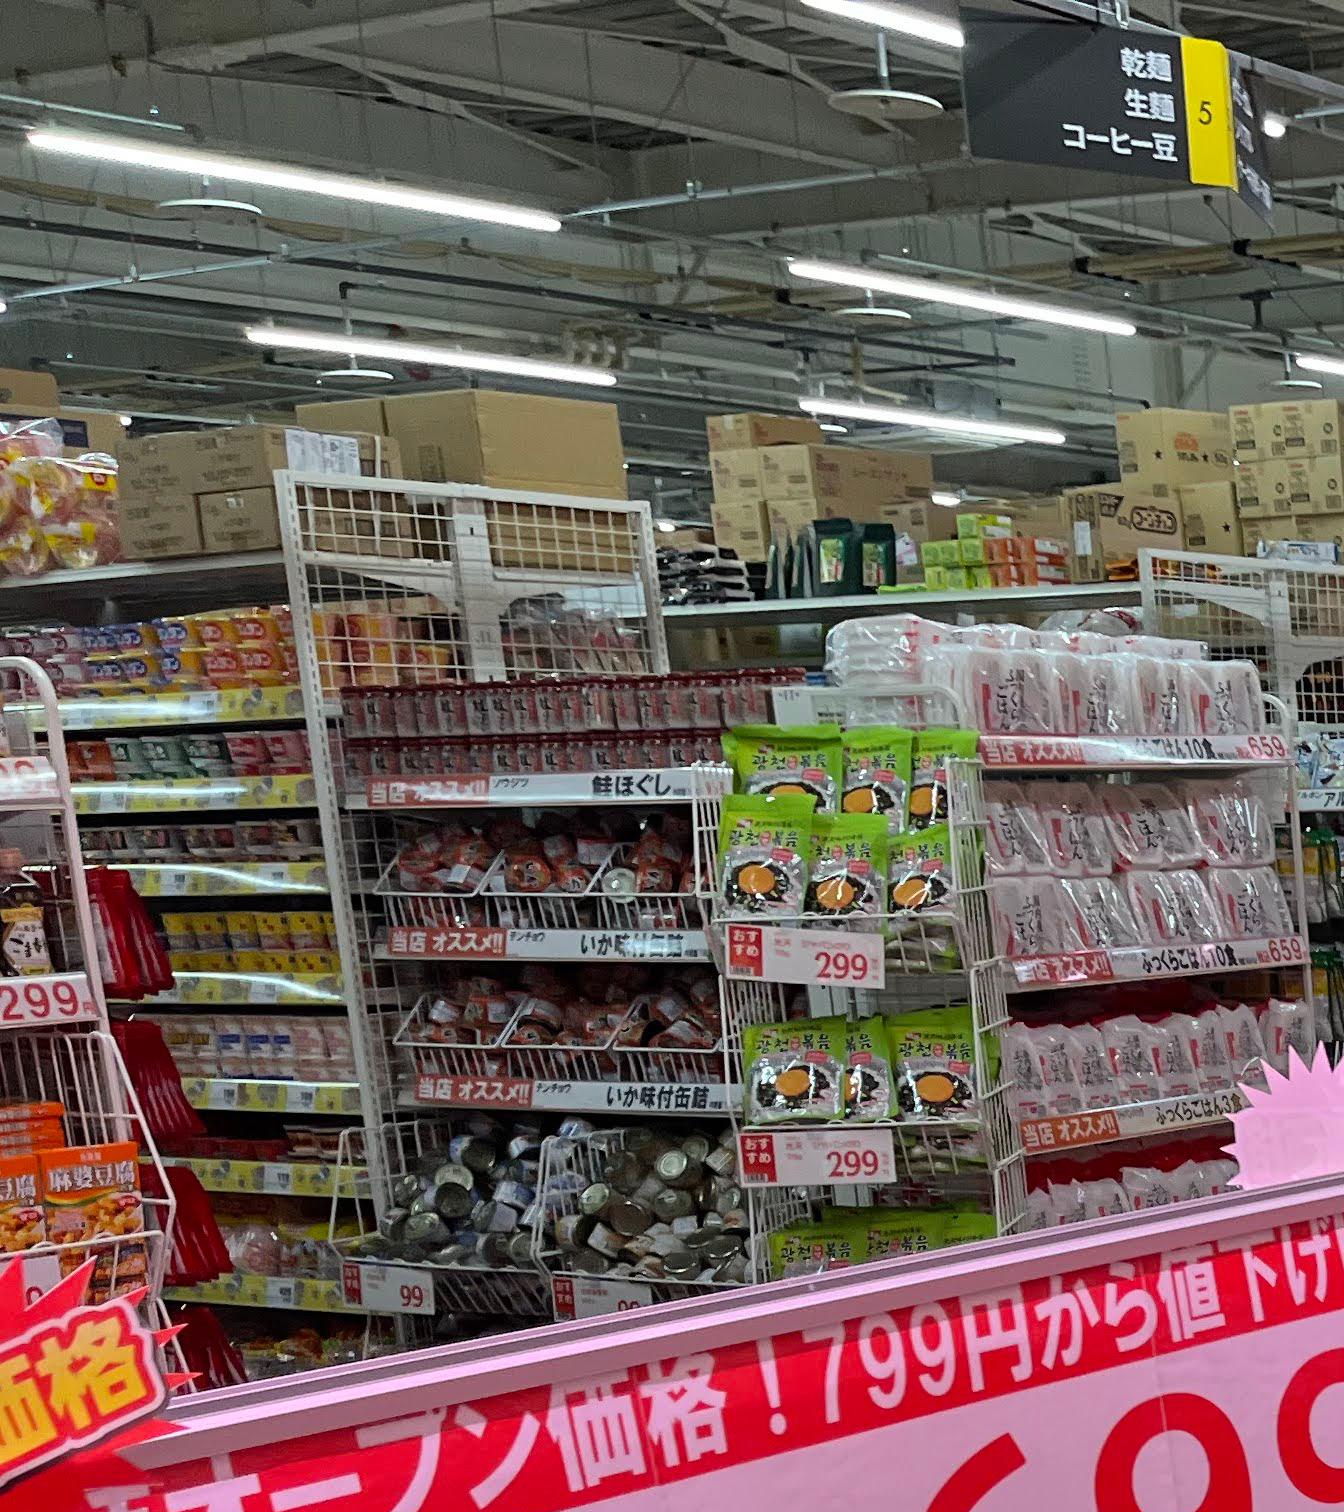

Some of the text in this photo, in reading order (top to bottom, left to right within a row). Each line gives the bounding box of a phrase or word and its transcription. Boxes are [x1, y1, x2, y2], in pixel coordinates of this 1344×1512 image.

[1120, 47, 1173, 82] 乾麺
[1124, 89, 1176, 123] 生麺
[1198, 101, 1212, 125] 5
[1062, 123, 1178, 162] コーヒー豆
[1249, 734, 1286, 758] 659
[591, 773, 673, 798] 鮭ほぐし
[391, 930, 427, 954] 当店
[1268, 937, 1302, 962] 659
[814, 951, 869, 981] 299
[418, 1076, 711, 1110] 当店 オススメ!! いか味付缶詰
[1022, 1122, 1055, 1148] 当店
[826, 1149, 880, 1178] 299
[399, 1285, 425, 1309] 99
